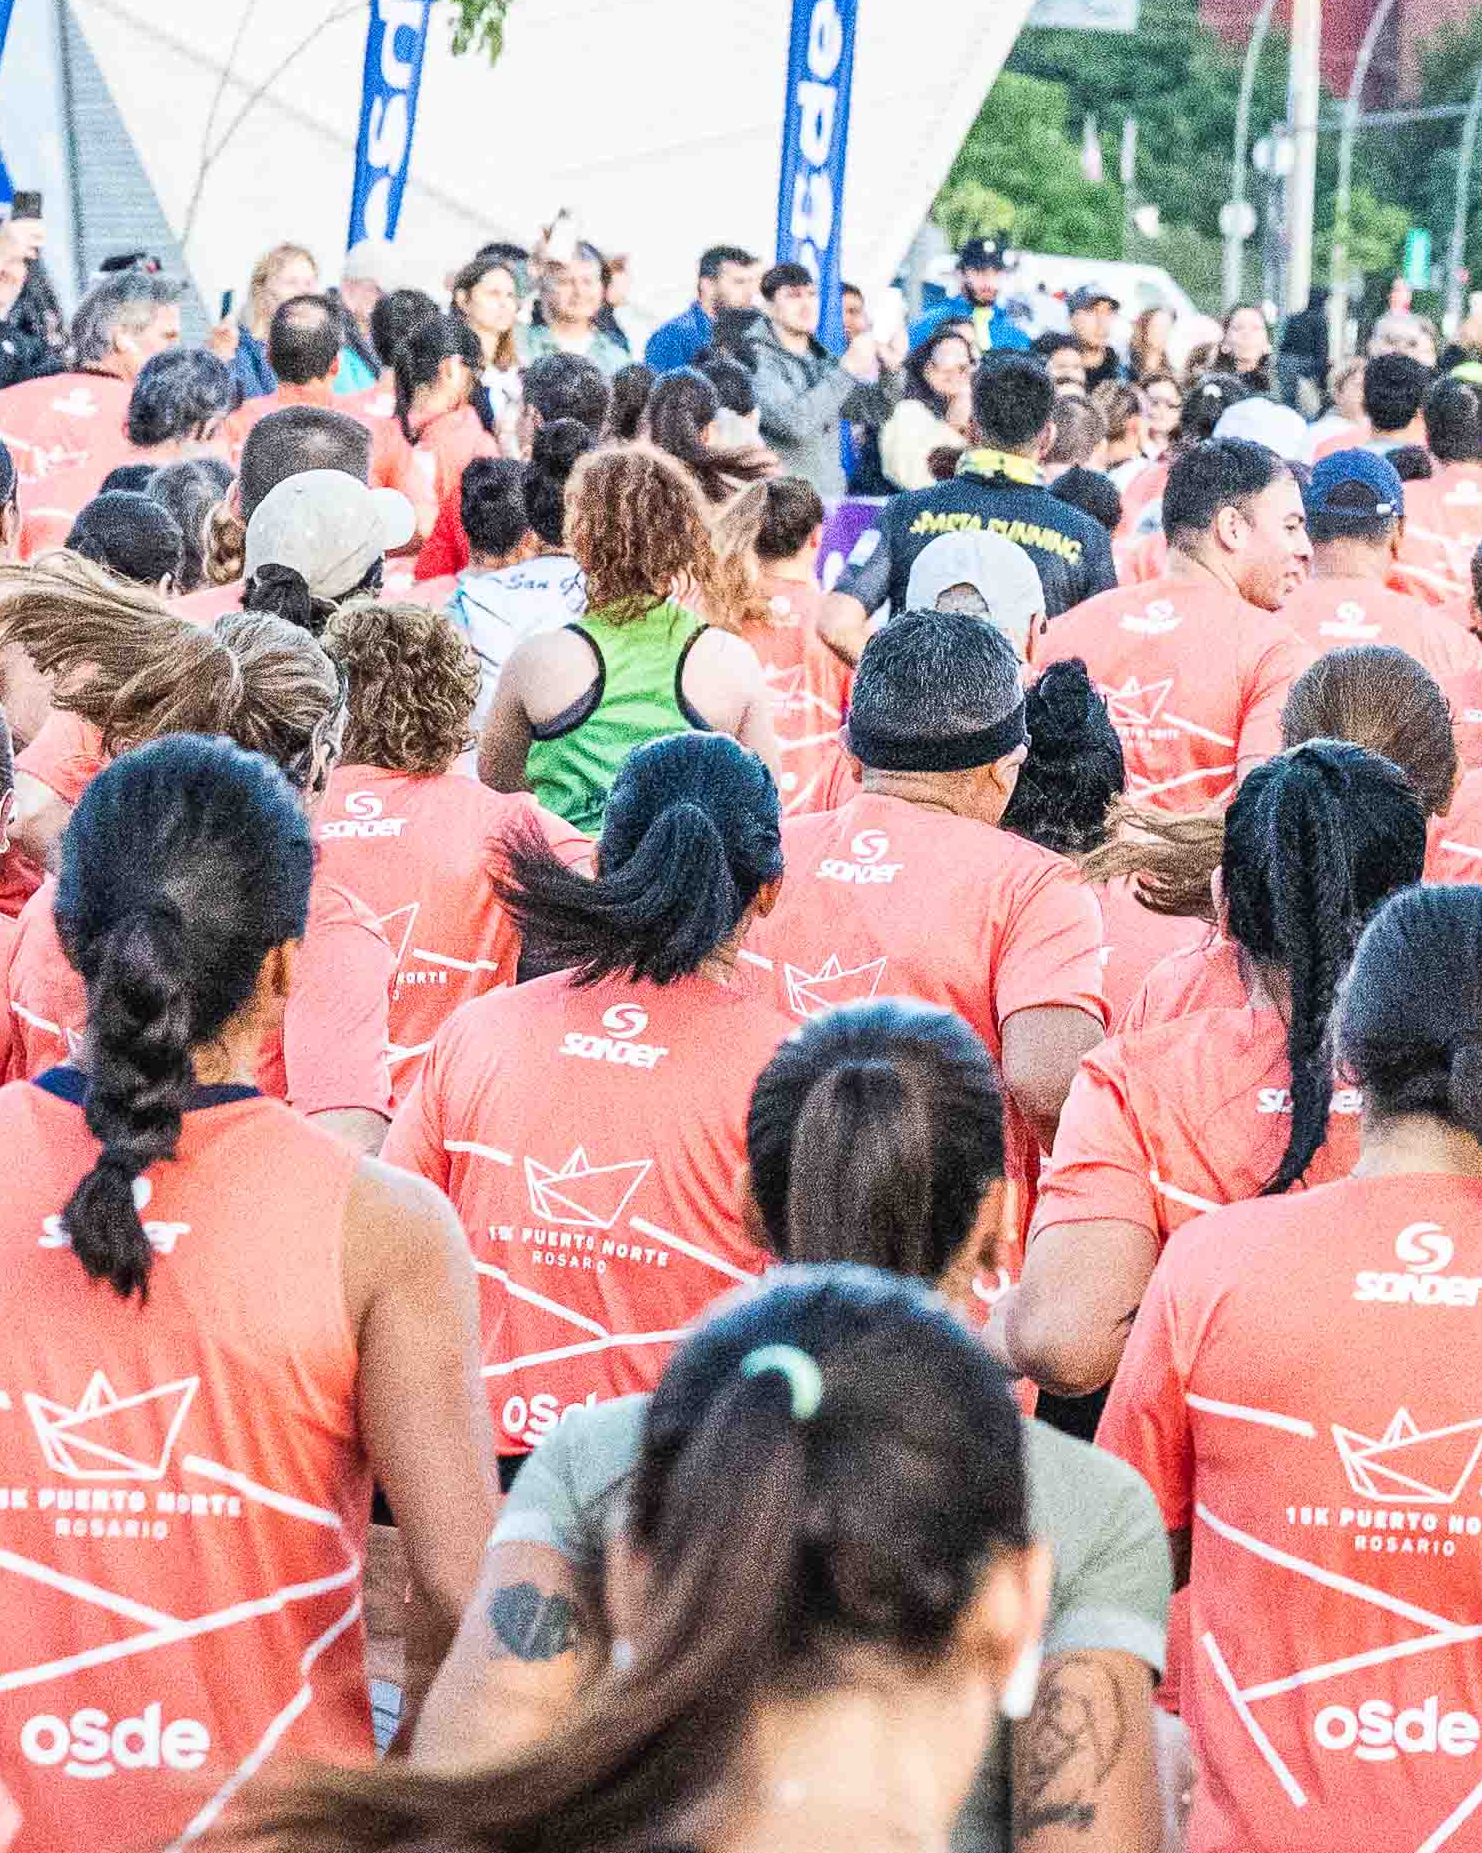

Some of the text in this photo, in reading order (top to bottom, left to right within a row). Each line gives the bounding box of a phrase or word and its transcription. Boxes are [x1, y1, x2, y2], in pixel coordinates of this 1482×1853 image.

[602, 1239, 670, 1268] NORTE
[38, 1488, 147, 1513] PUERTO
[156, 1490, 242, 1517] NORTE
[54, 1517, 169, 1541] ROSARIO
[1338, 1507, 1439, 1532] PUERTO
[1353, 1534, 1456, 1558] ROSARIO
[20, 1700, 212, 1781] osde
[1313, 1695, 1481, 1762] osde
